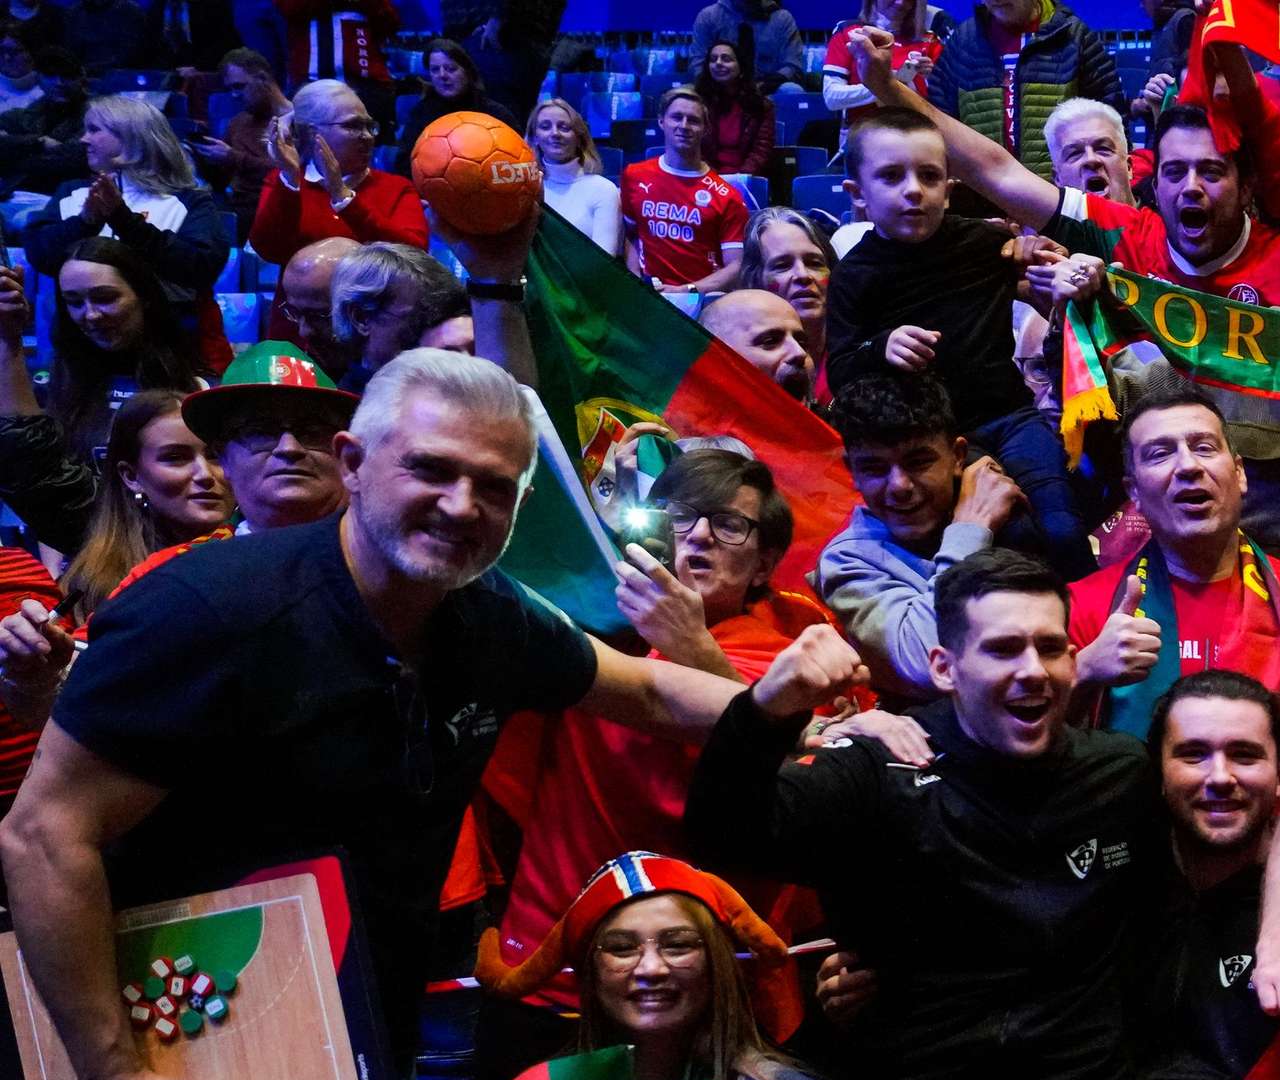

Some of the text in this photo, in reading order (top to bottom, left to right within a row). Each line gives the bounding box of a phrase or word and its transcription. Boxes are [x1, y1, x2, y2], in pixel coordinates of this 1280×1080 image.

[702, 177, 730, 197] DNB
[643, 201, 702, 225] REMA
[647, 223, 695, 242] 1000
